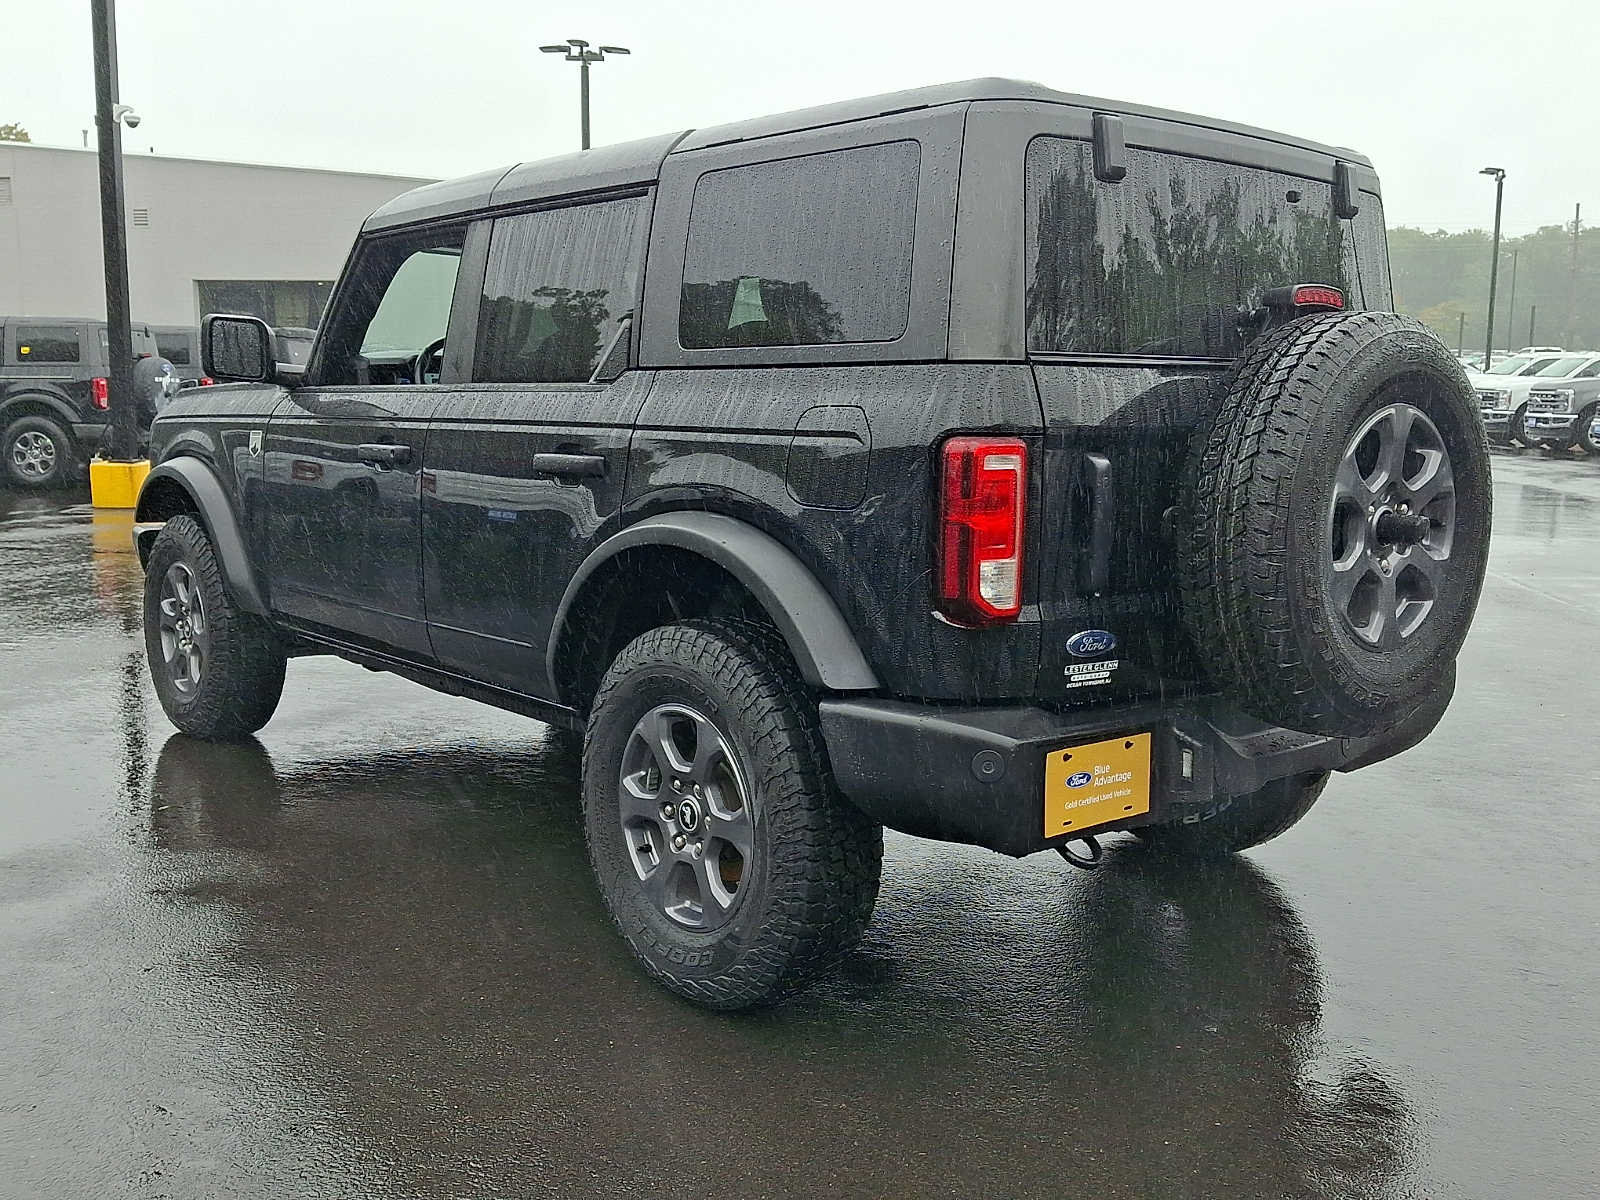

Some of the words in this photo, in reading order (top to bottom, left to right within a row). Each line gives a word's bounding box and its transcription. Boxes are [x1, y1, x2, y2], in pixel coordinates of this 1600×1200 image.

[1094, 764, 1111, 776] Blue
[1094, 771, 1132, 787] Advantage
[1064, 800, 1078, 810] Gold
[1078, 795, 1100, 807] Certified
[1099, 791, 1113, 801] Used
